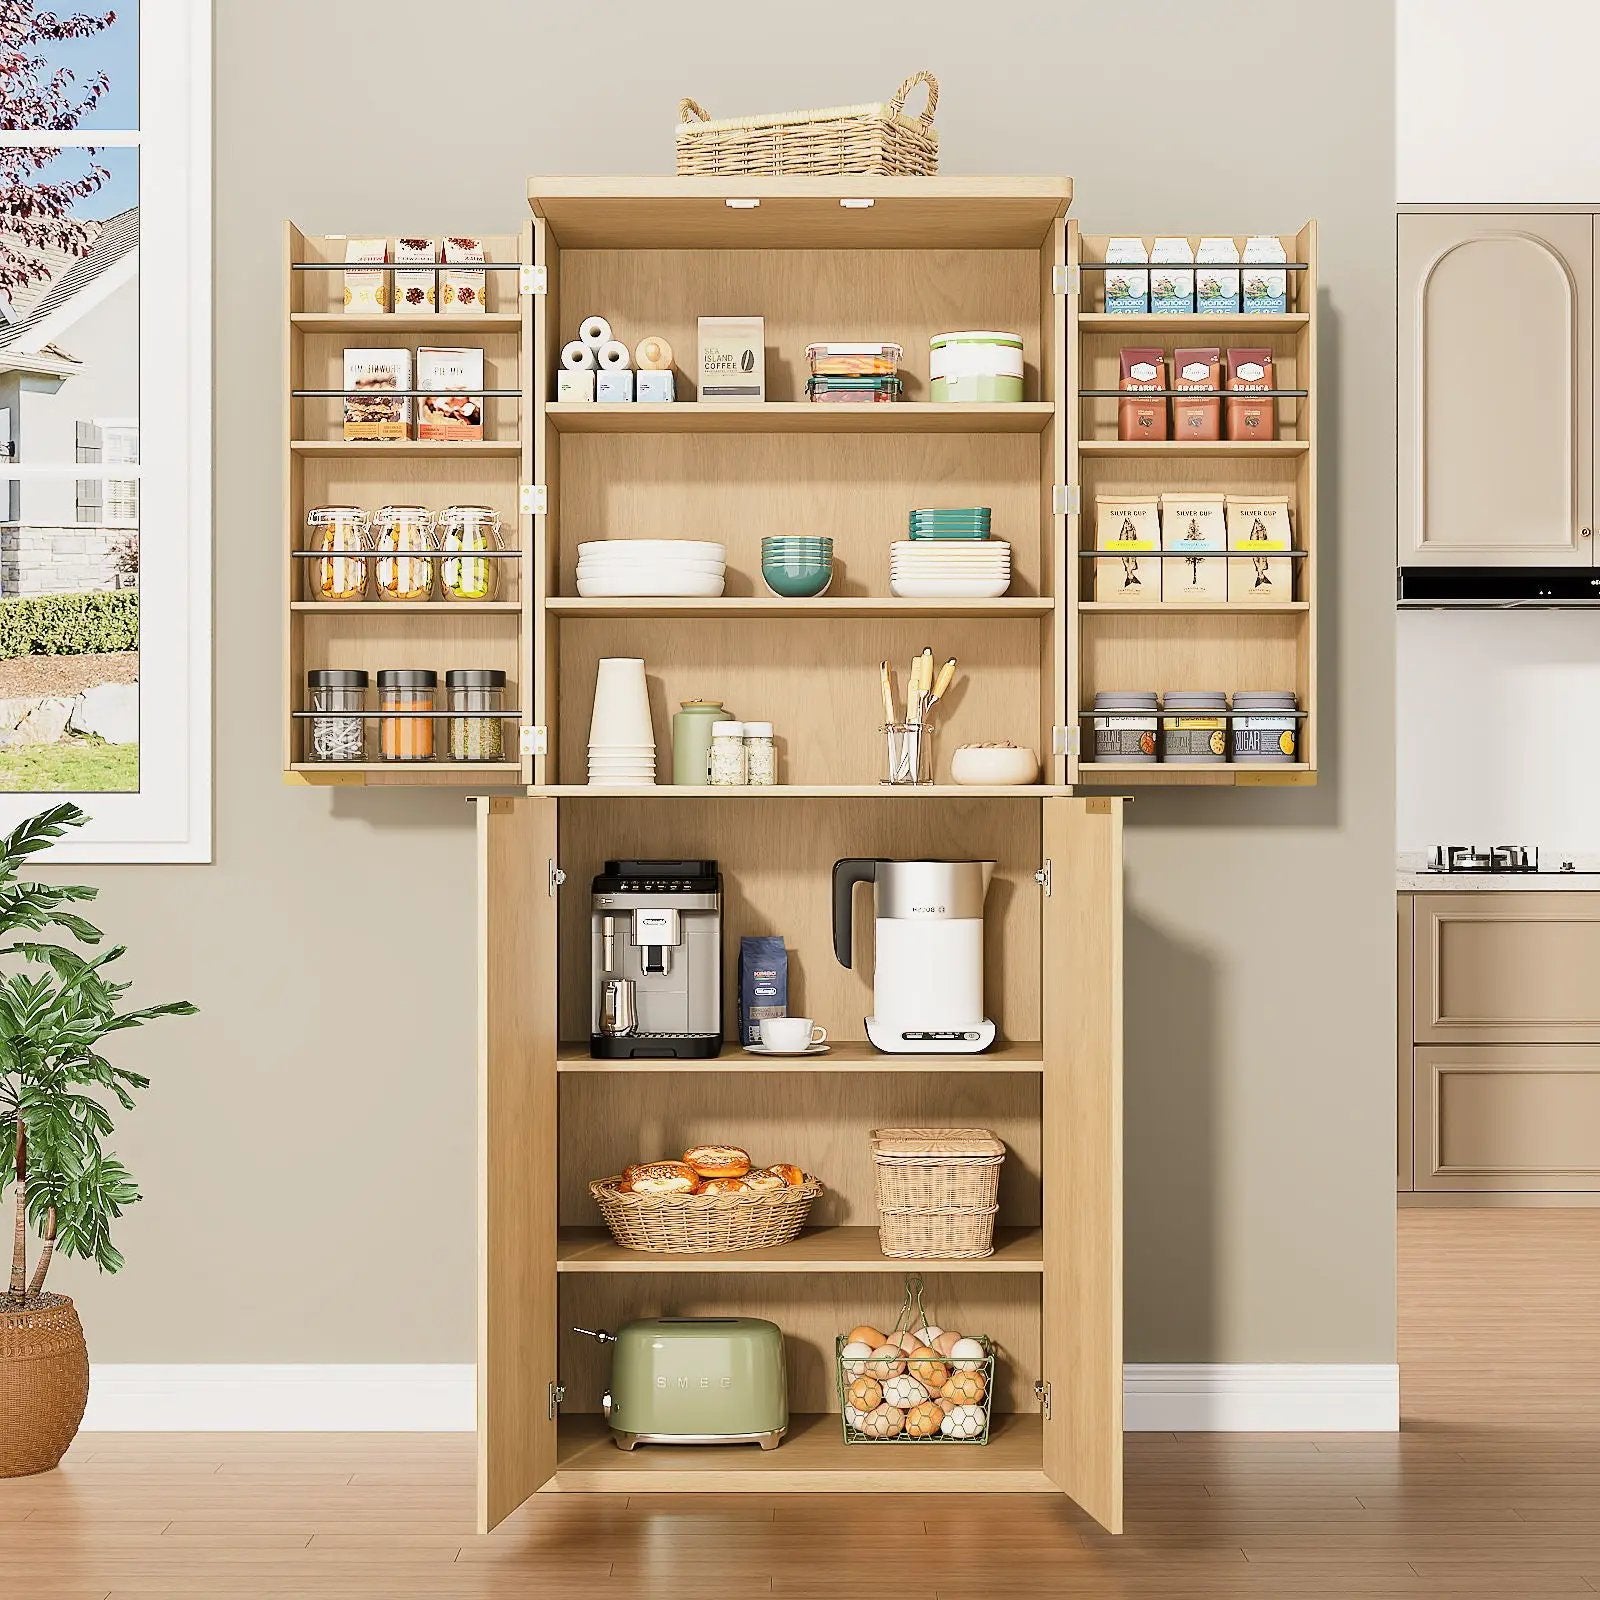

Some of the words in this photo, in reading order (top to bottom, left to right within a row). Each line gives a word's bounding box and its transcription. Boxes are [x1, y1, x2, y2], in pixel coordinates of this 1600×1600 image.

[704, 347, 720, 355] SEA
[704, 354, 734, 362] ISLAND
[704, 362, 738, 370] COFFEE
[1235, 730, 1260, 751] SUGAR
